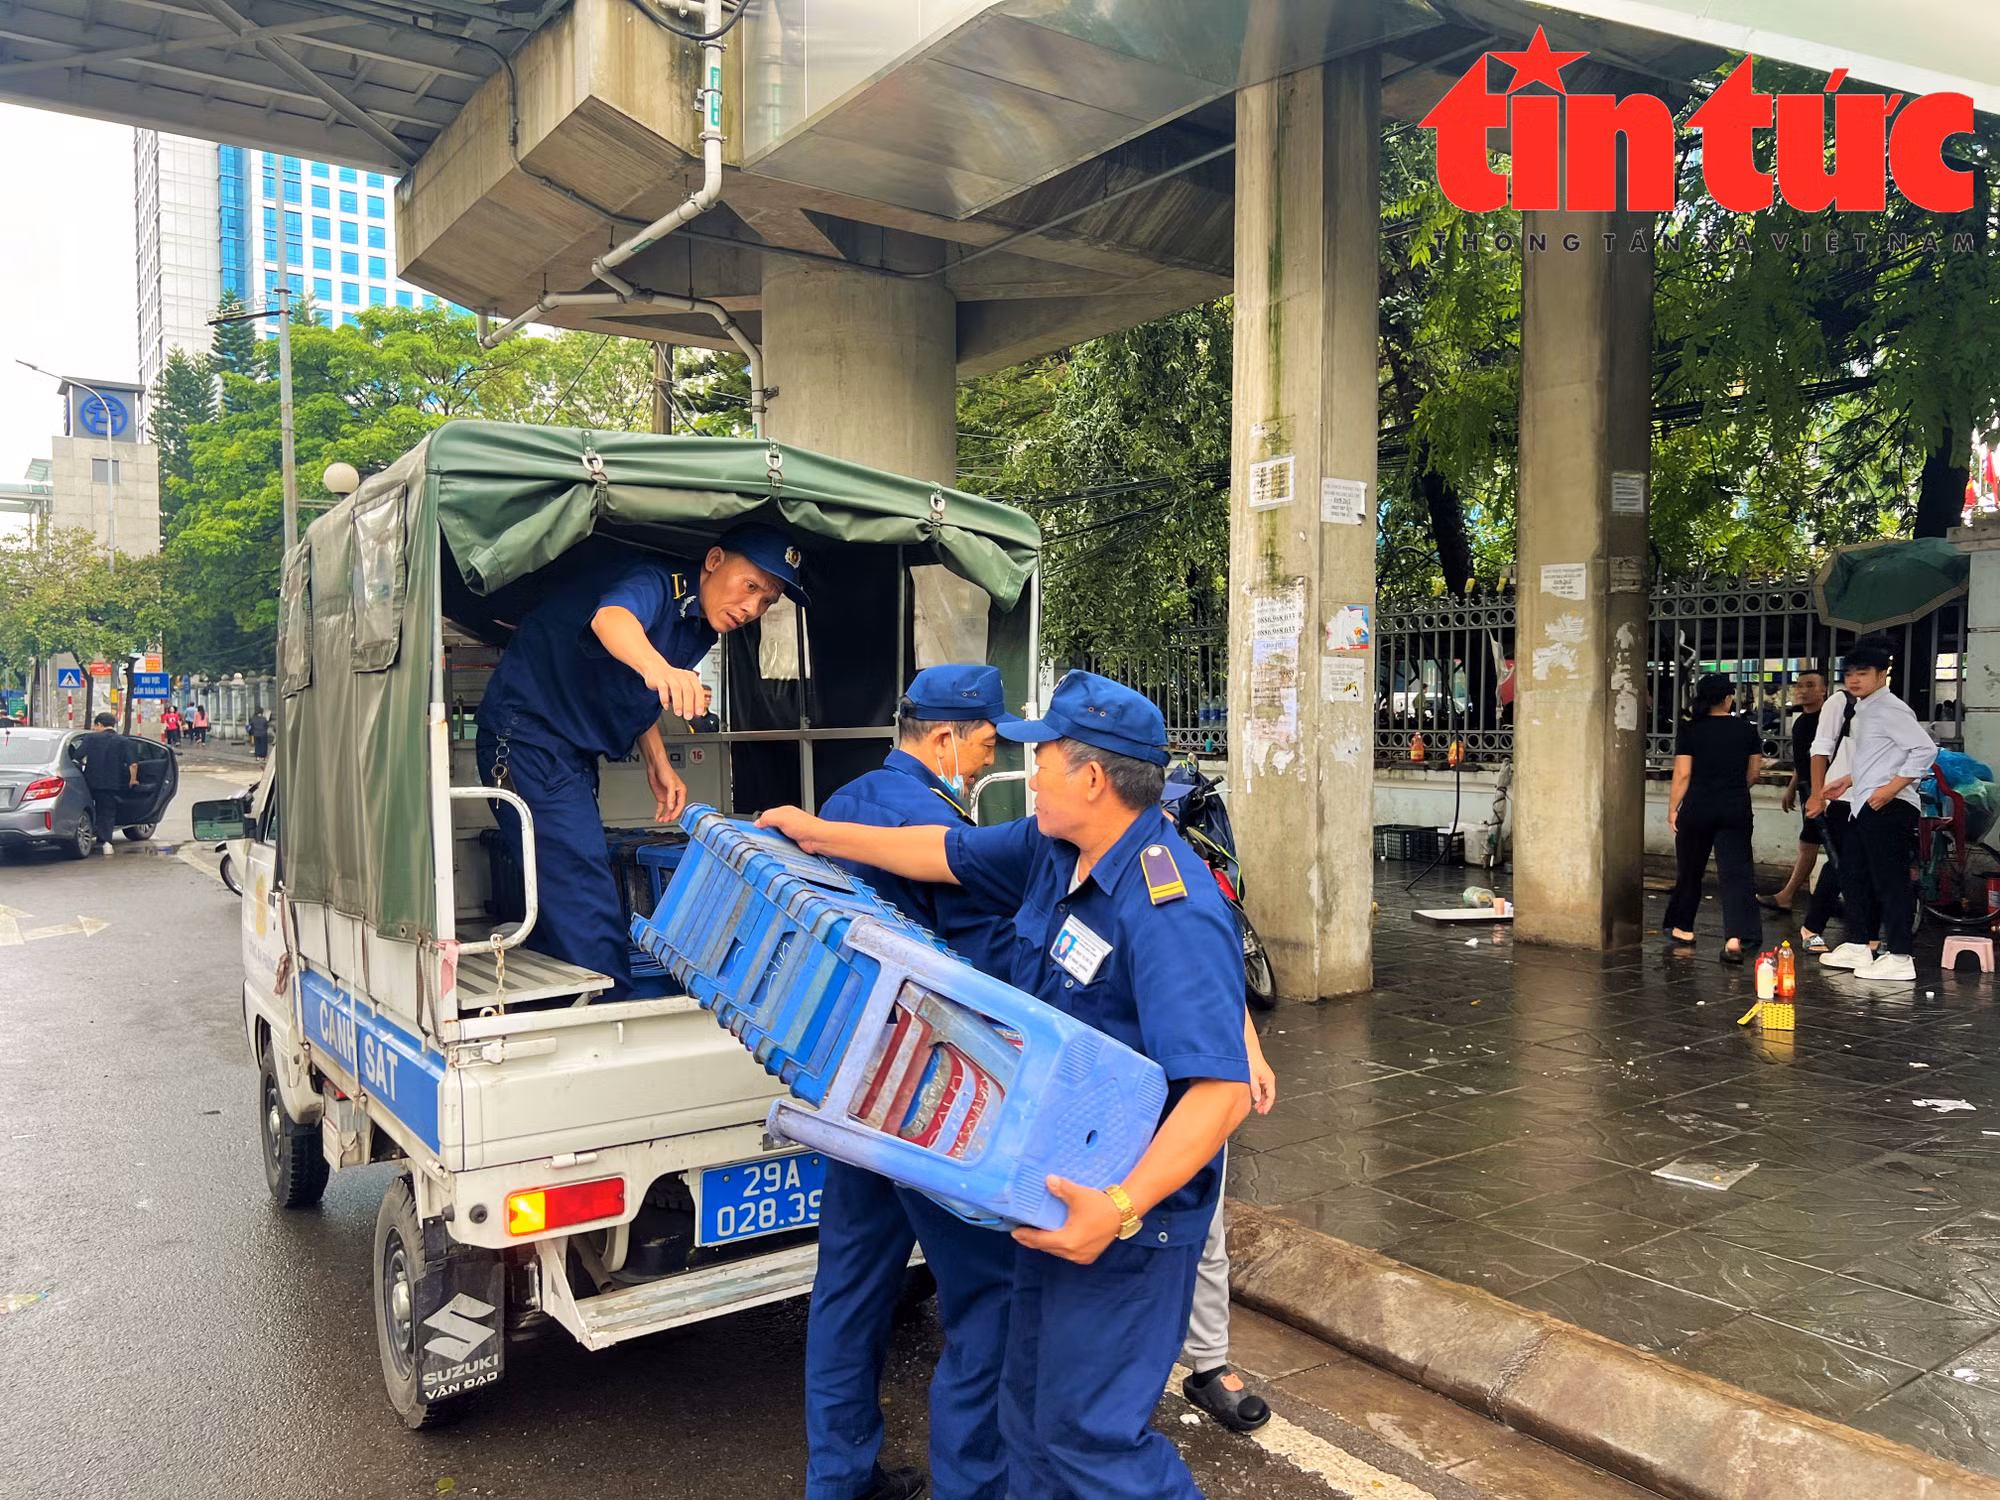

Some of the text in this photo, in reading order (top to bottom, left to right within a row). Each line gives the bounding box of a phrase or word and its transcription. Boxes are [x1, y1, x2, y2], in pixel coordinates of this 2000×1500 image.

[692, 750, 703, 760] 16
[743, 1159, 801, 1197] 29A
[422, 1354, 499, 1386] SUZUKI
